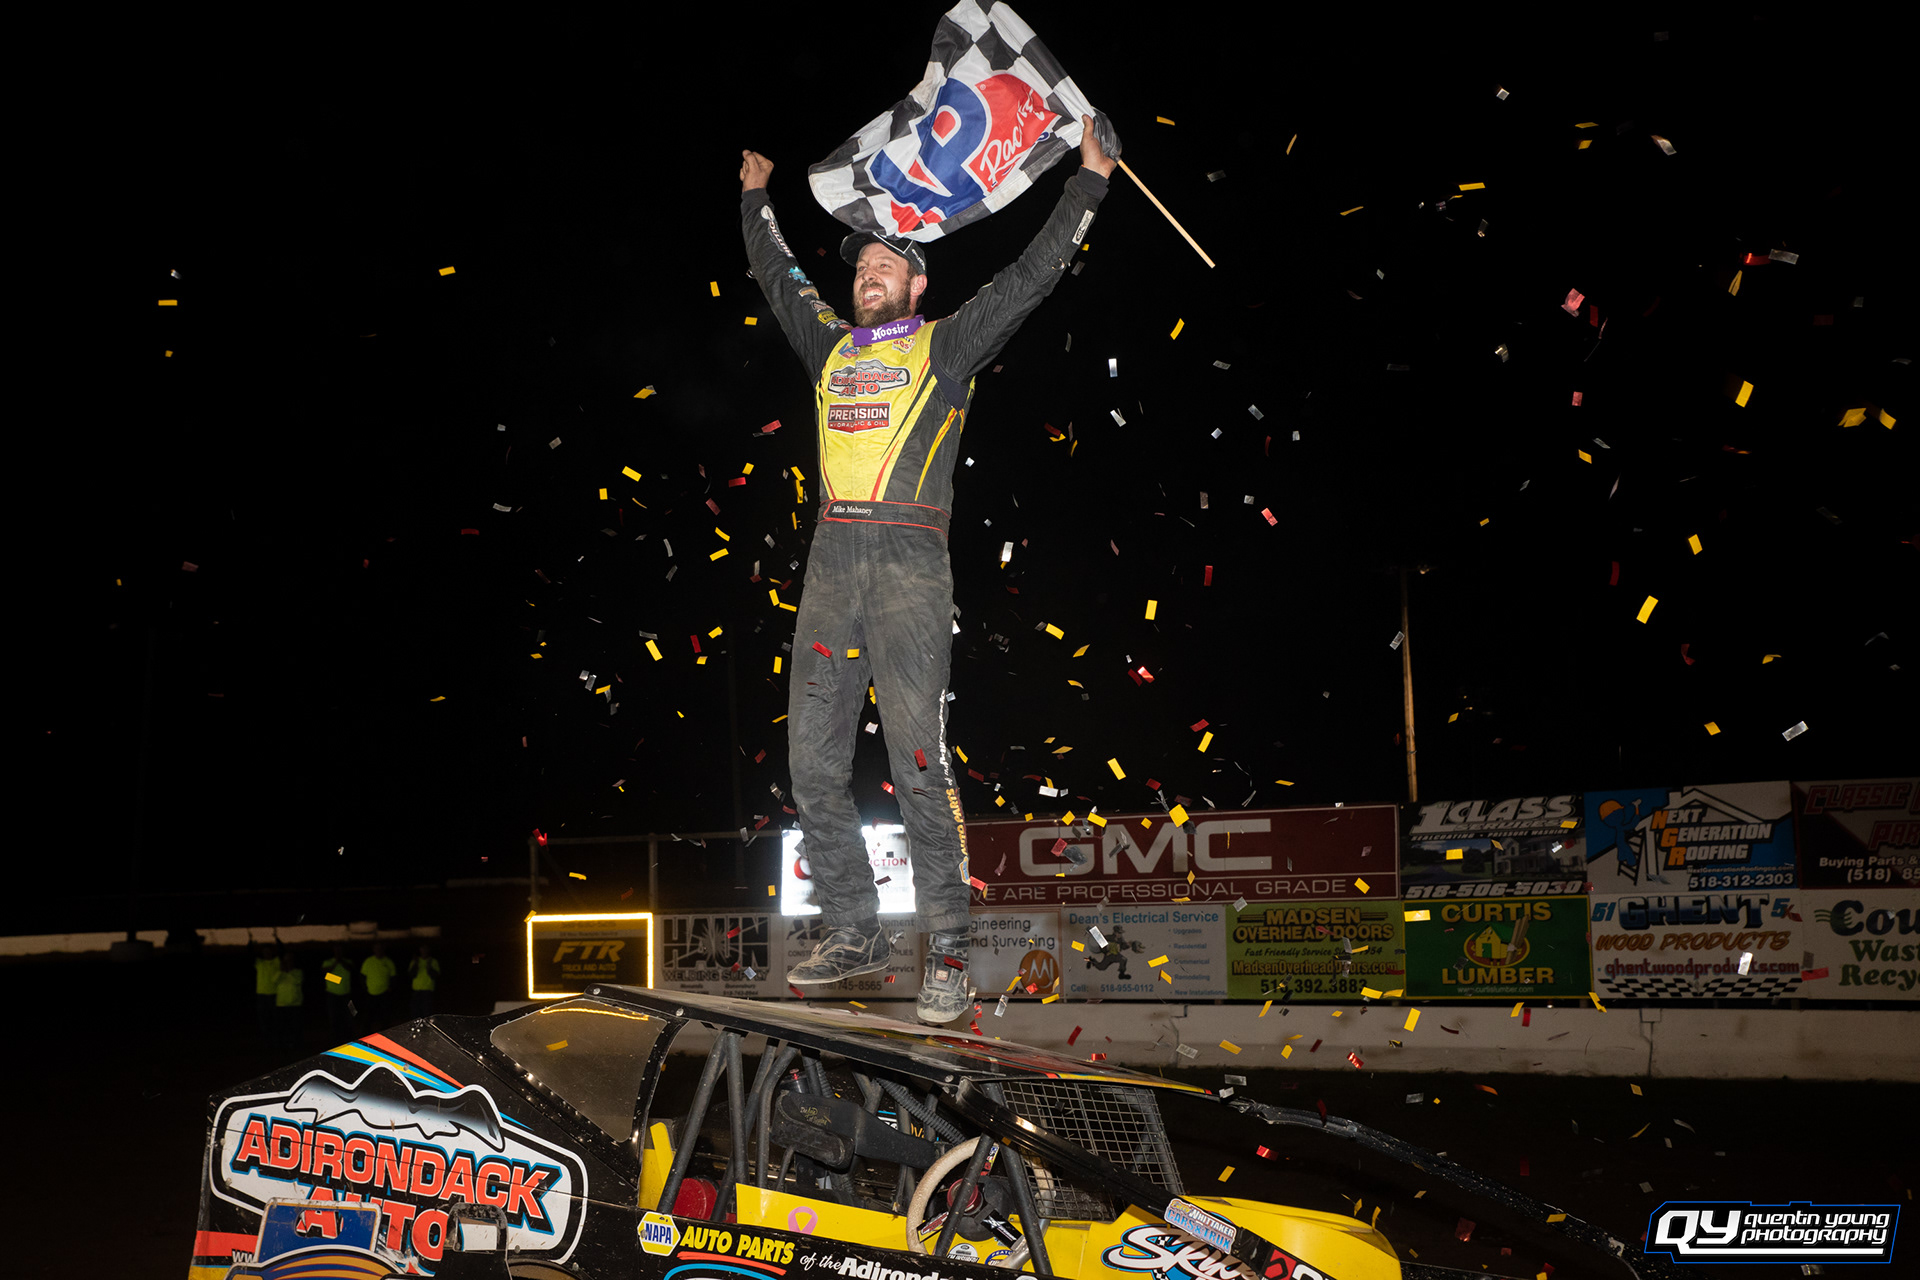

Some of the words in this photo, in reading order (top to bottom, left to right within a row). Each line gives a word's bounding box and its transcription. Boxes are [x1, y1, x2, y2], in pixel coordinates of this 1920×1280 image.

[872, 324, 909, 340] Hoosier
[841, 382, 879, 395] AUTO
[829, 407, 888, 421] PRECISION
[832, 505, 845, 514] Mike
[846, 505, 873, 516] Mahaney
[1804, 783, 1912, 815] CLASSIC
[1651, 808, 1703, 830] NEXT
[1660, 823, 1773, 847] GENERATION
[1019, 817, 1273, 877] GMC
[1667, 844, 1749, 866] ROOFING
[1819, 856, 1865, 868] Buying
[1868, 855, 1905, 866] Parts
[1689, 873, 1794, 888] 518-312-2303
[1847, 867, 1892, 883] (518)
[1003, 885, 1046, 900] ARE
[1057, 881, 1243, 899] PROFESSIONAL
[1256, 879, 1347, 895] GRADE
[1405, 880, 1583, 899] 518-506-5030
[1069, 912, 1108, 924] Dean's
[1113, 911, 1169, 924] Electrical
[1172, 911, 1219, 923] Service
[1265, 907, 1361, 926] MADSEN
[1441, 901, 1552, 923] CURTIS
[1591, 902, 1616, 921] 51
[1618, 893, 1770, 930] GHENT
[970, 917, 1031, 932] gineering
[1234, 925, 1328, 942] OVERHEAD
[1332, 924, 1394, 941] DOORS
[662, 916, 768, 969] HAUN
[971, 935, 988, 948] nd
[992, 933, 1056, 950] Surveying
[1595, 933, 1655, 951] WOOD
[1659, 931, 1792, 951] PRODUCTS
[552, 939, 626, 963] FTR
[1244, 948, 1263, 957] Fast
[1264, 947, 1299, 958] Friendly
[1300, 947, 1333, 957] Service
[663, 970, 720, 981] WELDING
[721, 970, 769, 981] SUPLY
[1232, 959, 1398, 976] MadsenOverheadDors.com
[1442, 967, 1554, 985] LUMBER
[1604, 957, 1800, 979] ghentwoodproduts.com
[1838, 963, 1920, 991] Recy
[838, 981, 882, 991] 745-8565
[1070, 984, 1089, 993] Cell:
[1101, 983, 1154, 993] 518-955-0112
[232, 1115, 556, 1224] ADIRONDACK
[296, 1183, 451, 1262] ATO
[1167, 1209, 1196, 1231] CARS
[1203, 1227, 1231, 1250] TRUX
[1188, 1206, 1235, 1238] WHITTAKER
[644, 1222, 672, 1245] NAPA
[679, 1225, 733, 1254] AUTO
[735, 1234, 796, 1265] PARTS
[799, 1252, 817, 1271] of
[818, 1255, 842, 1271] the
